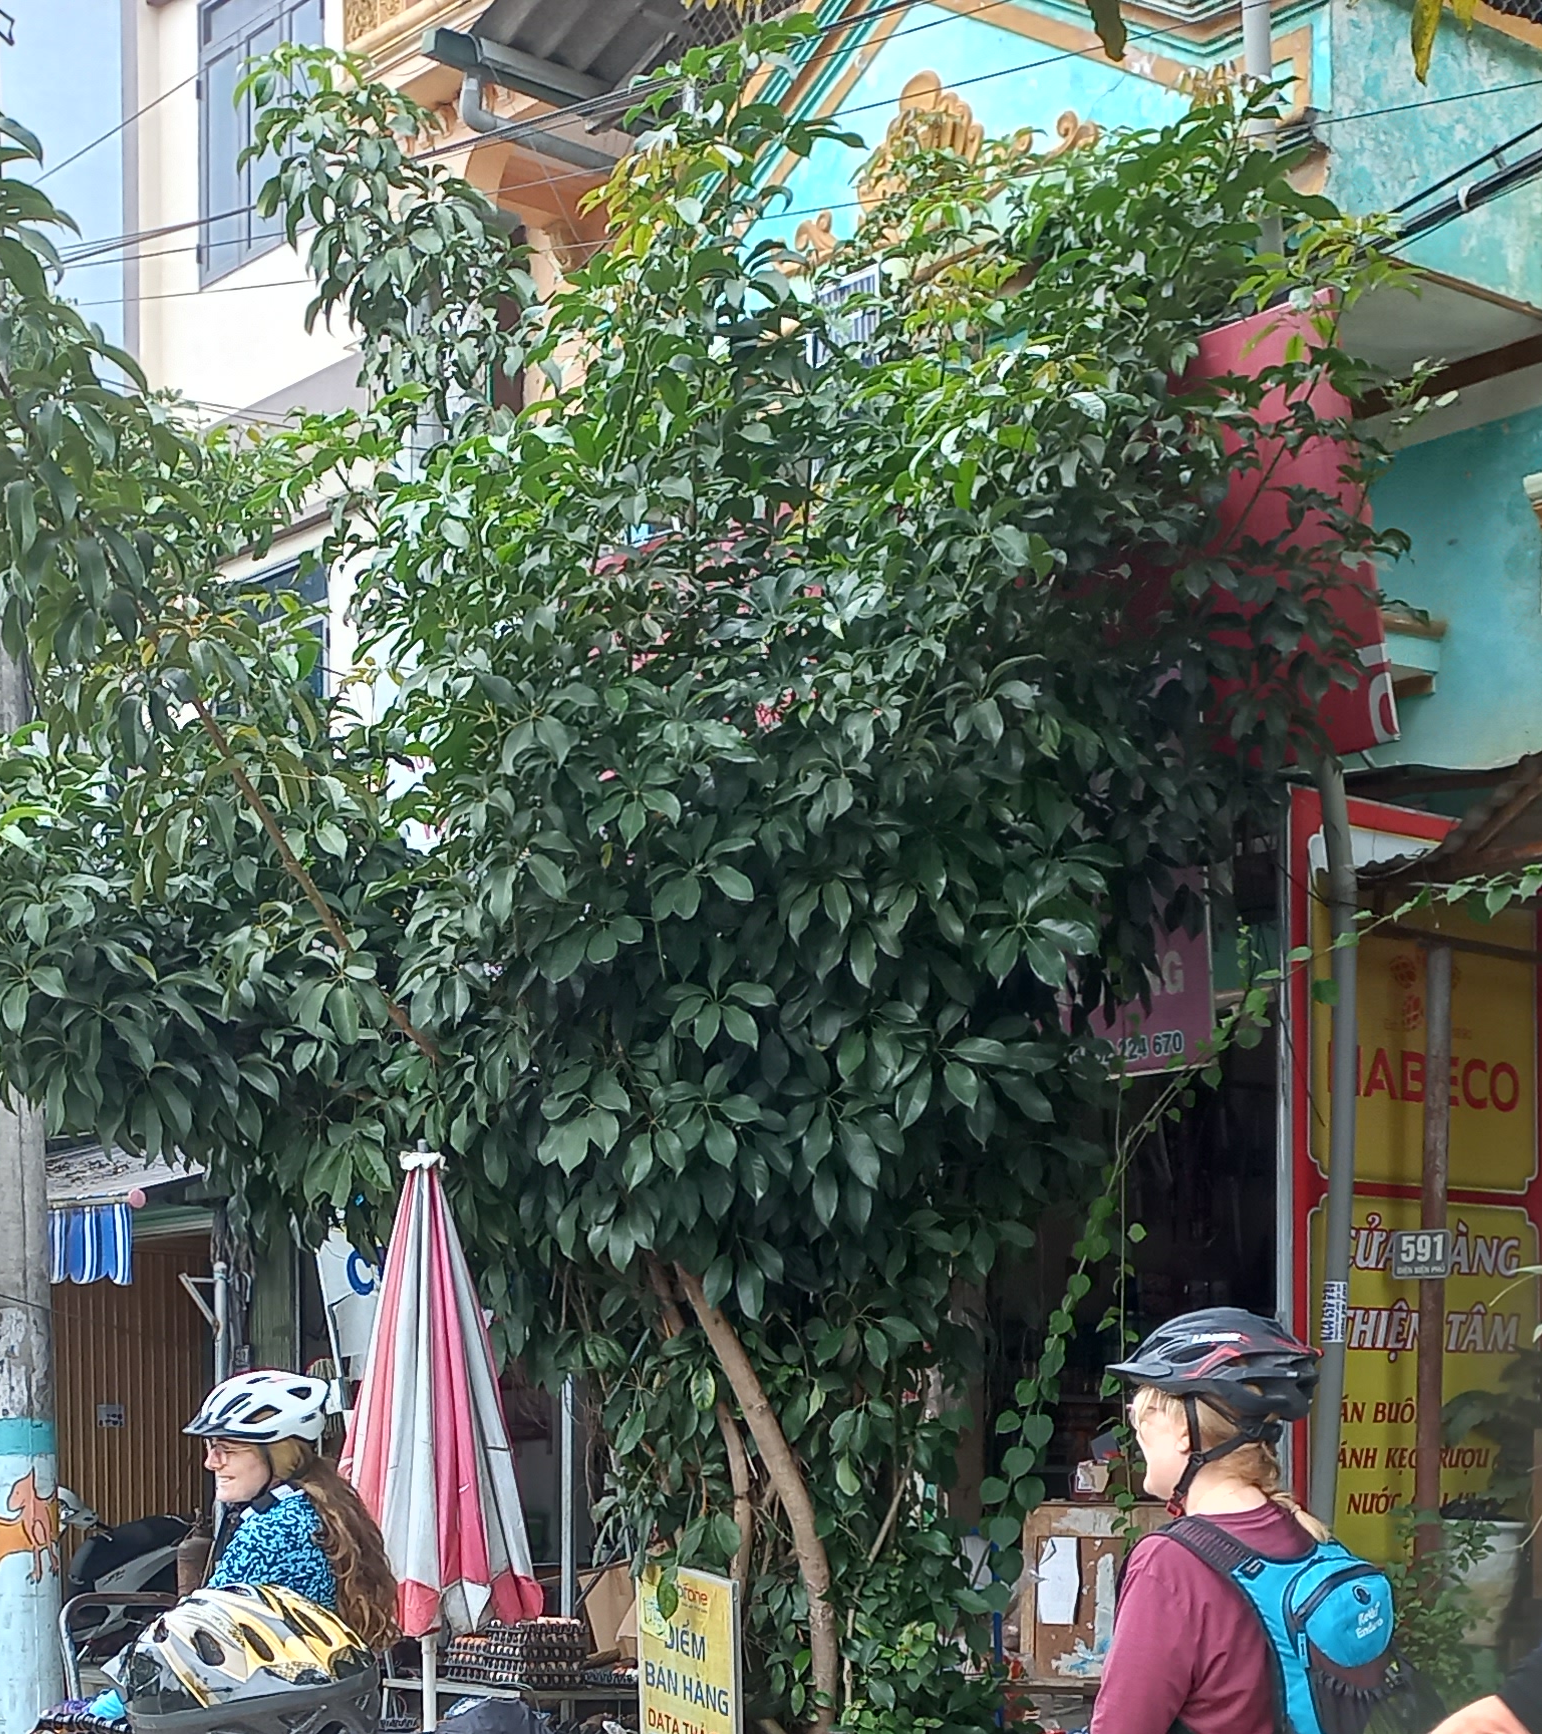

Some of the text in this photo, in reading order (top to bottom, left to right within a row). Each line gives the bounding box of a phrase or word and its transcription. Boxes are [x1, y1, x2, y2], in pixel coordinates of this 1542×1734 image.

[1152, 1030, 1184, 1057] 670
[1400, 1234, 1445, 1263] 591
[1450, 1218, 1521, 1278] ÀNG
[1445, 1303, 1519, 1352] TÂM
[1341, 1394, 1417, 1424] ÁN BUÔ
[1338, 1441, 1377, 1469] ÁNH
[645, 1660, 729, 1717] BÁN HÀNG
